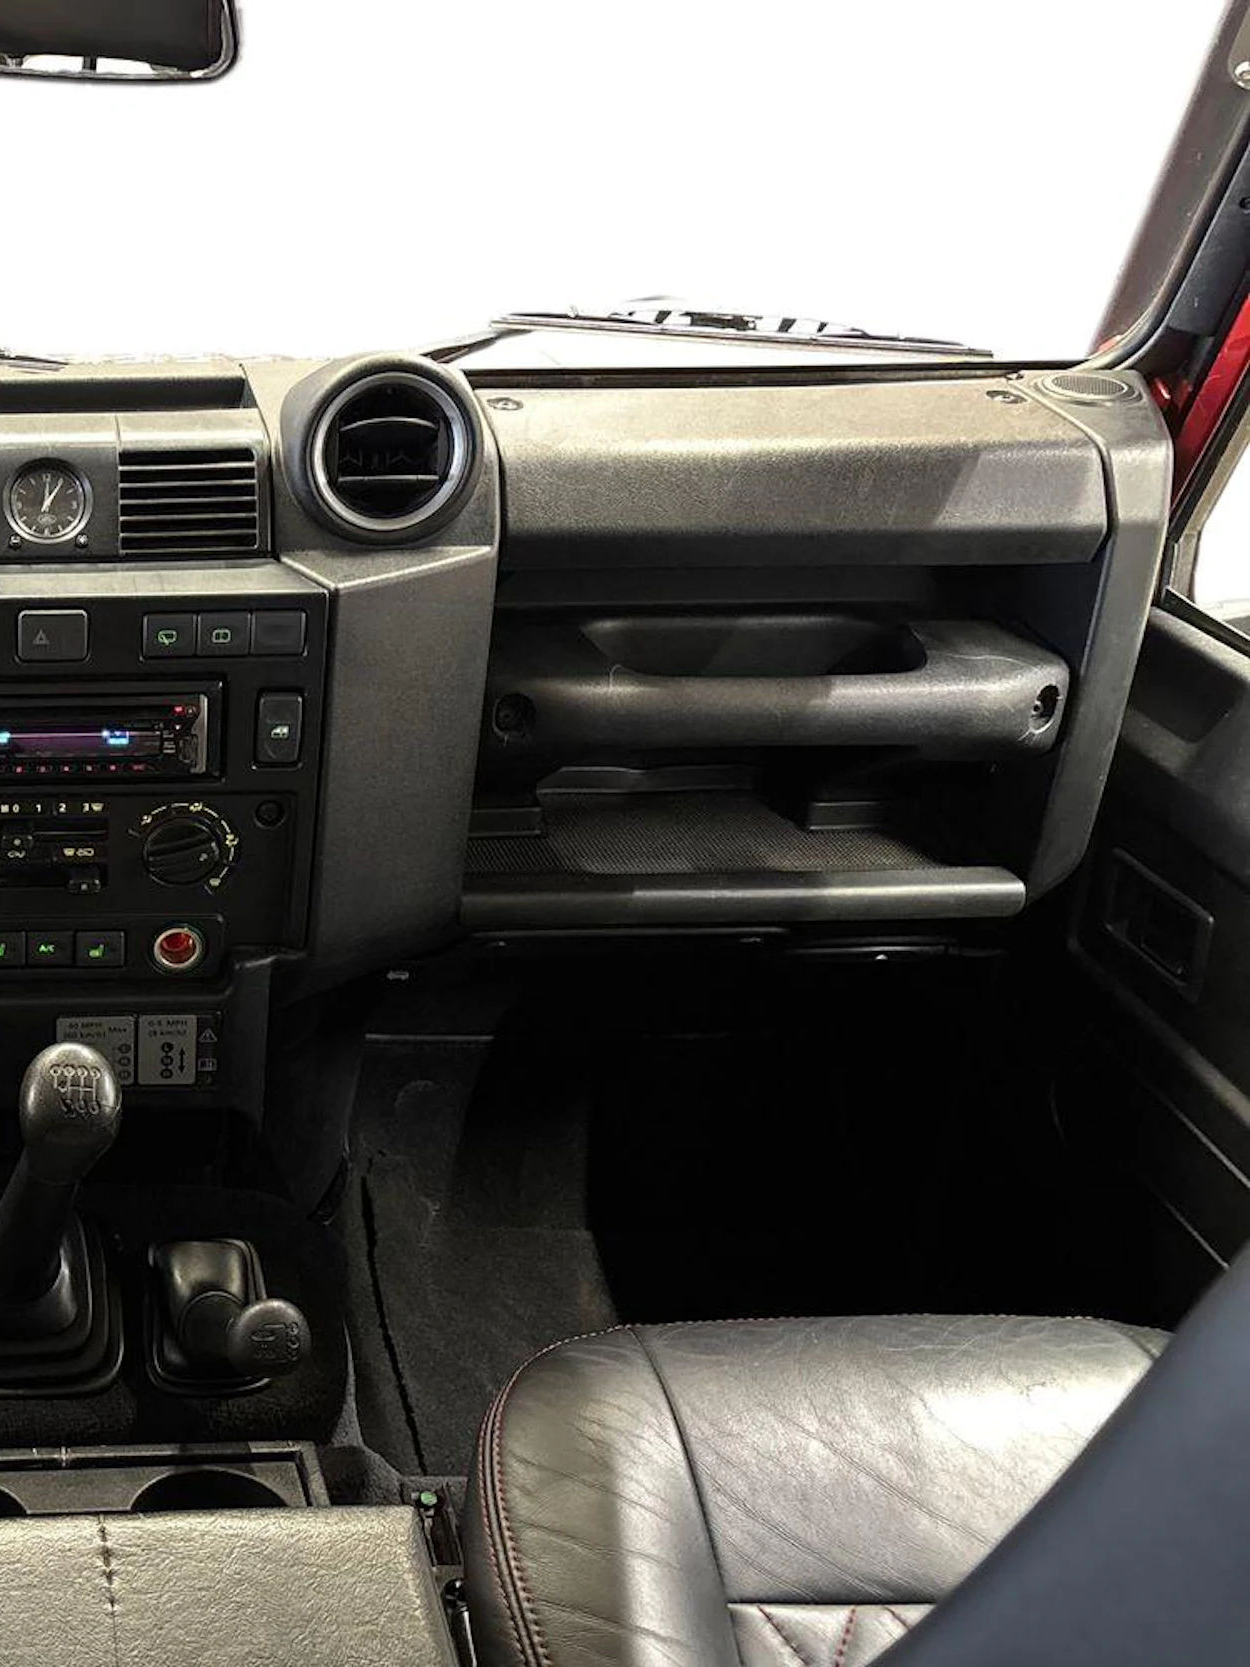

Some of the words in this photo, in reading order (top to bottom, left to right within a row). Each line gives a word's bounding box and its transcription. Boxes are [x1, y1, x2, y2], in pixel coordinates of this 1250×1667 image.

[12, 803, 20, 814] 0
[35, 803, 42, 813] 1
[58, 802, 67, 814] 2
[82, 802, 90, 813] 3
[38, 943, 56, 954] A/C
